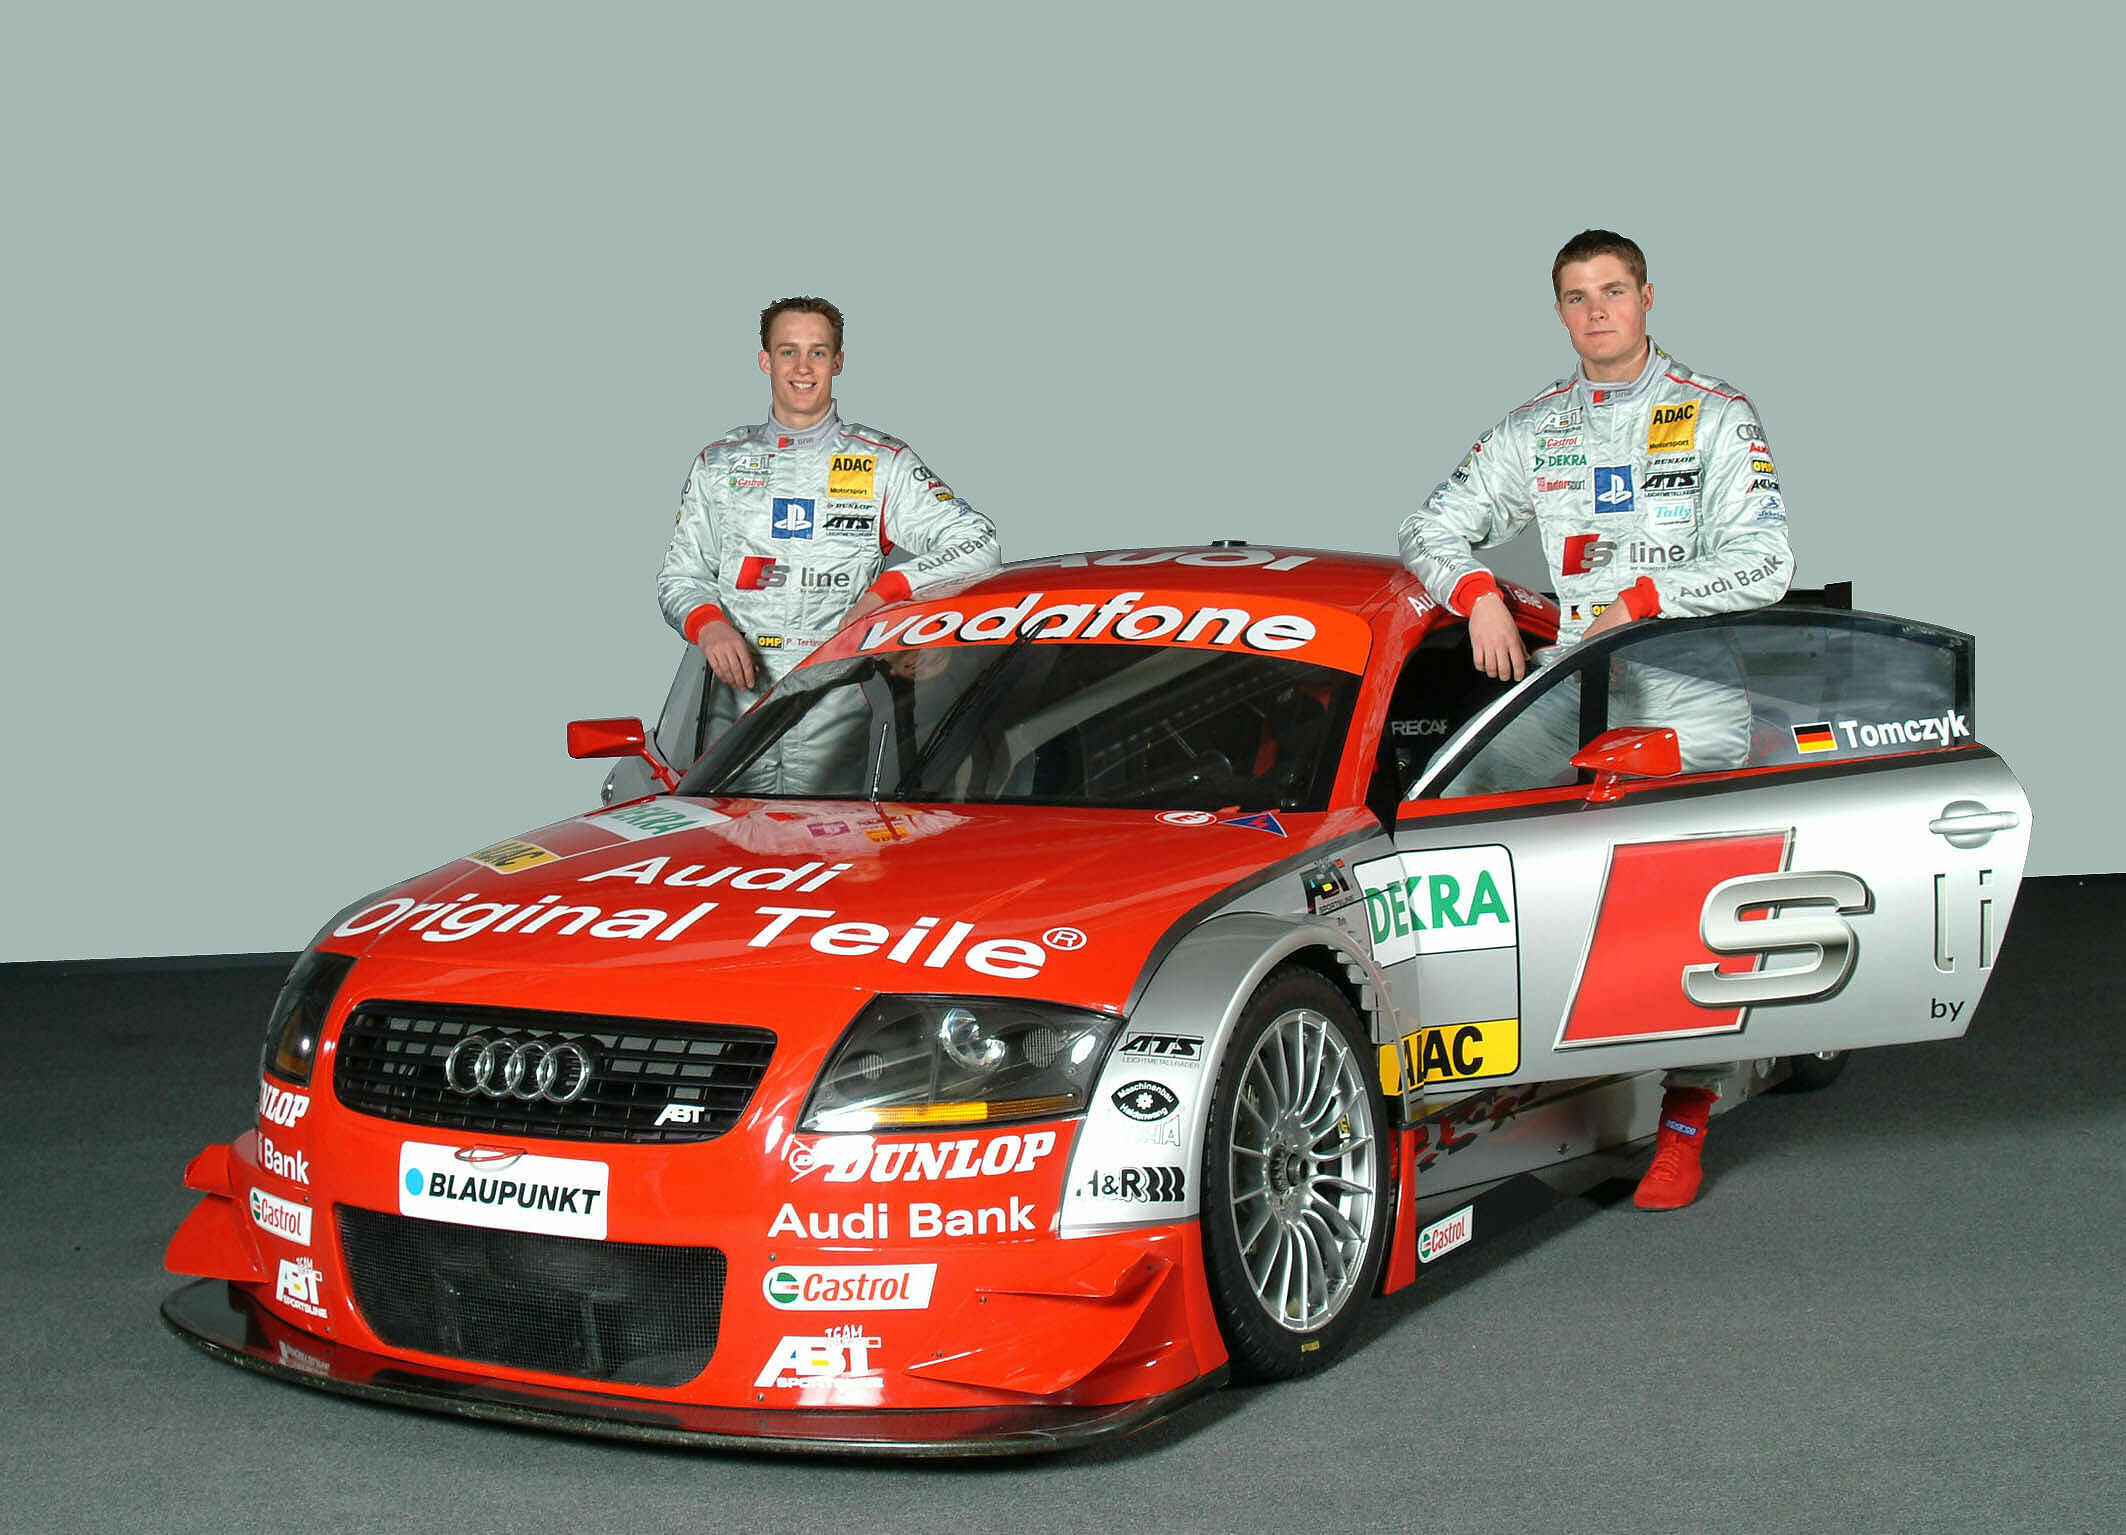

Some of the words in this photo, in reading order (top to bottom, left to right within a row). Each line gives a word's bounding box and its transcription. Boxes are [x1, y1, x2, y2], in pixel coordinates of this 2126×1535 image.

[1653, 404, 1695, 425] ADAC
[1547, 436, 1578, 448] Castrol
[1649, 439, 1690, 449] Motorsport
[831, 457, 873, 472] ADAC
[1548, 454, 1588, 467] DEKRA
[1653, 456, 1696, 466] DUNLOP
[737, 477, 766, 488] Castrol
[1640, 470, 1701, 490] ATS
[834, 502, 874, 510] DUNLOP
[1655, 505, 1693, 520] Tally
[822, 516, 877, 530] ATS
[918, 547, 961, 572] Audi
[1580, 540, 1618, 569] S
[1629, 541, 1686, 563] line
[756, 564, 791, 588] S
[800, 567, 850, 588] line
[1679, 575, 1733, 599] Audi
[1734, 555, 1785, 587] Bank
[859, 591, 1316, 652] vodafone
[758, 636, 782, 648] OMP
[1391, 718, 1448, 737] RECA
[1838, 709, 1970, 750] Tomczyk
[576, 855, 855, 893] Audi
[332, 892, 720, 943] Original
[1364, 869, 1511, 945] DEKRA
[1933, 867, 1993, 973] li
[1682, 869, 1876, 1009] S
[1930, 998, 1966, 1022] by
[1119, 1035, 1204, 1057] ATS
[260, 1080, 311, 1129] NLOP
[1117, 1081, 1176, 1103] Maschinenbau
[654, 1103, 705, 1127] ABT
[264, 1136, 311, 1185] Bank
[819, 1130, 1057, 1183] DUNLOP
[428, 1171, 601, 1215] BLAUPUNKT
[261, 1199, 302, 1237] Castrol
[767, 1202, 889, 1240] Audi
[908, 1195, 1036, 1239] Bank
[1431, 1217, 1466, 1254] Castrol
[803, 1272, 911, 1302] Castrol
[753, 1335, 882, 1388] ABT
